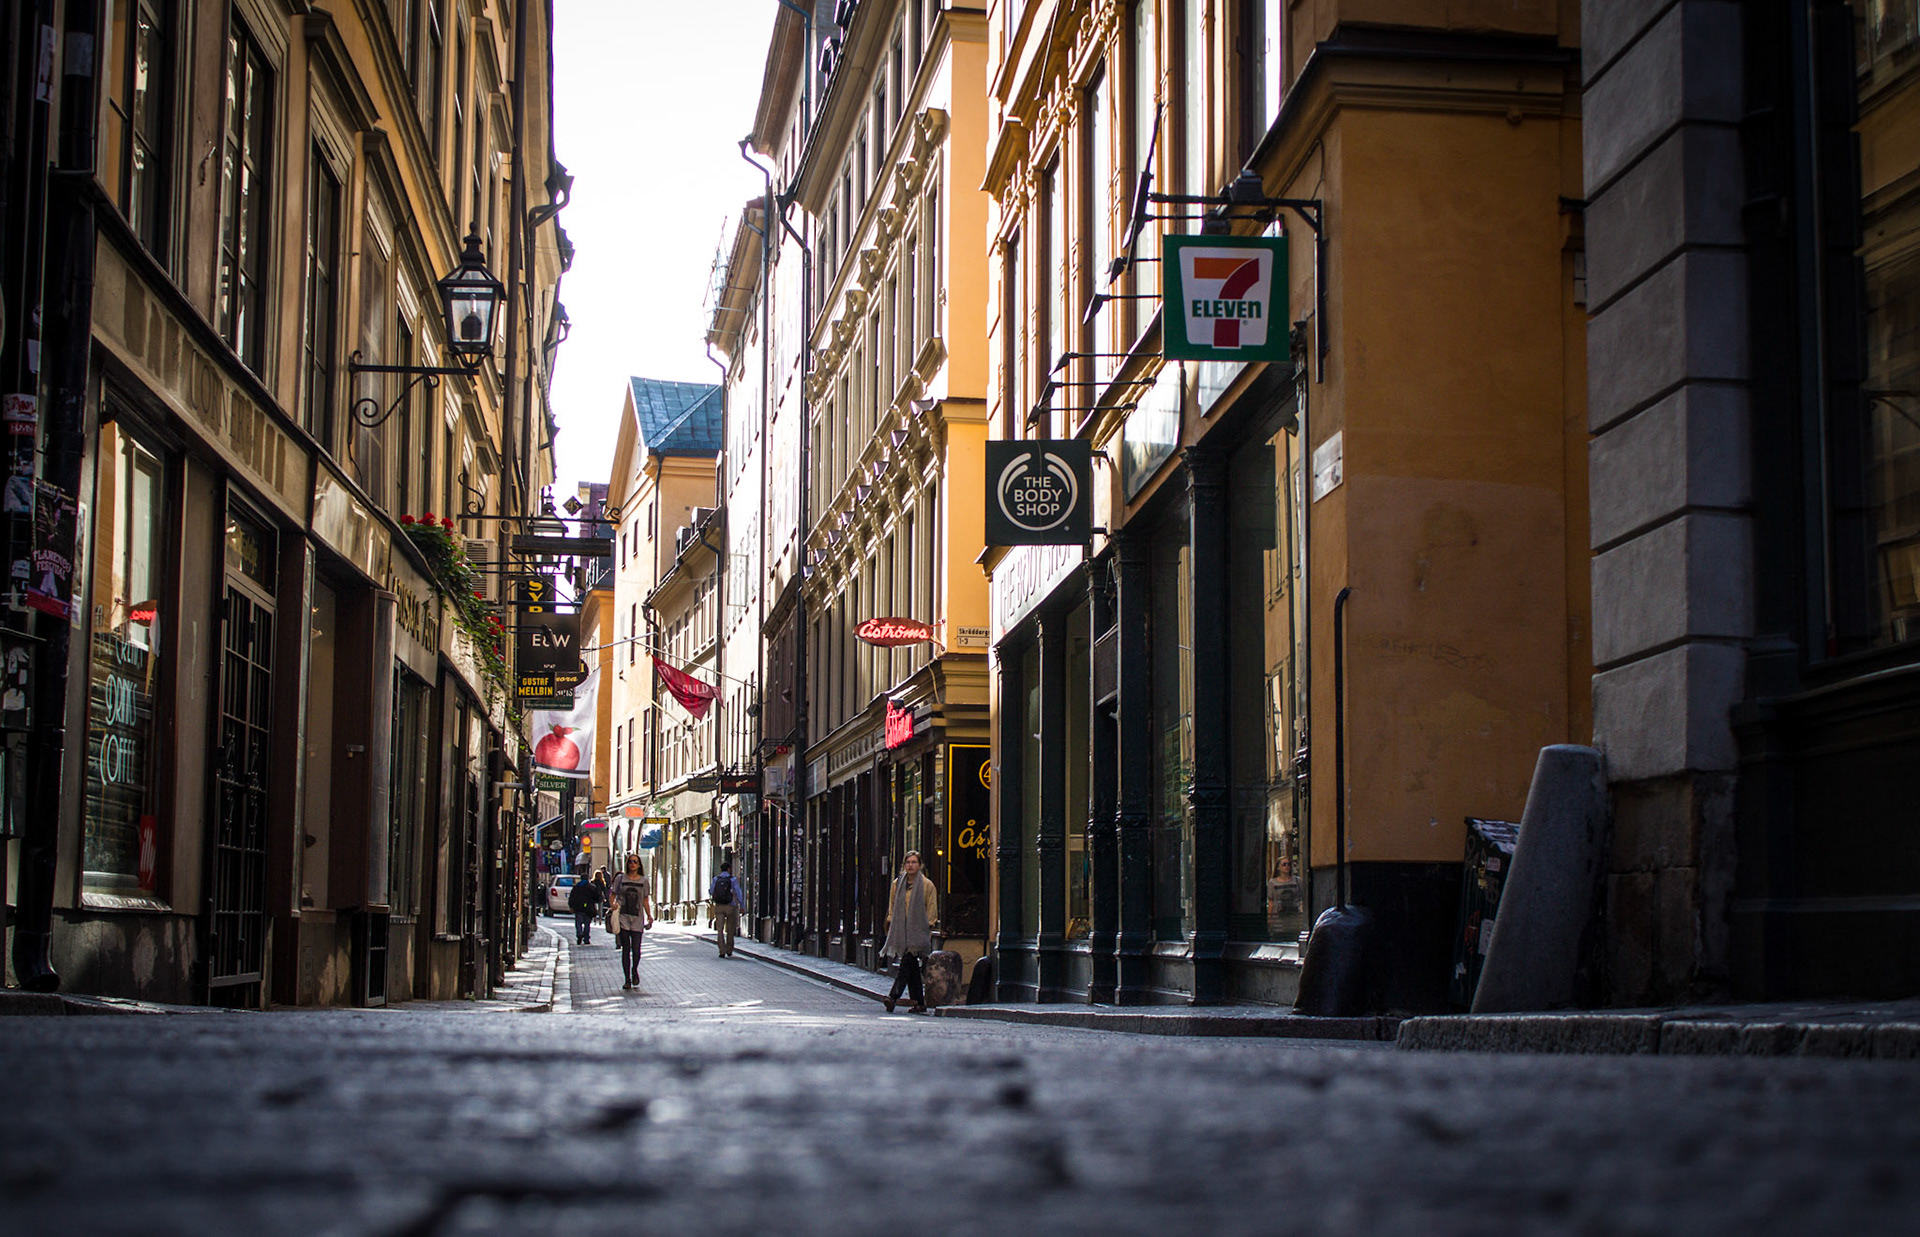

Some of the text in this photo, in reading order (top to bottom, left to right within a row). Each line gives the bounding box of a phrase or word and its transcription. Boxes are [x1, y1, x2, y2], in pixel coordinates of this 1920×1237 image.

[1194, 257, 1260, 348] 7
[1023, 475, 1052, 489] THE
[1014, 488, 1064, 502] BODY
[1016, 502, 1061, 517] SHOP
[858, 618, 930, 639] Åströms
[522, 677, 549, 686] GUSTAF
[518, 686, 553, 696] MELLBIN
[105, 673, 137, 726] DRINKS
[99, 733, 136, 786] COFFEE
[539, 781, 567, 789] SILVER
[140, 827, 156, 884] illy
